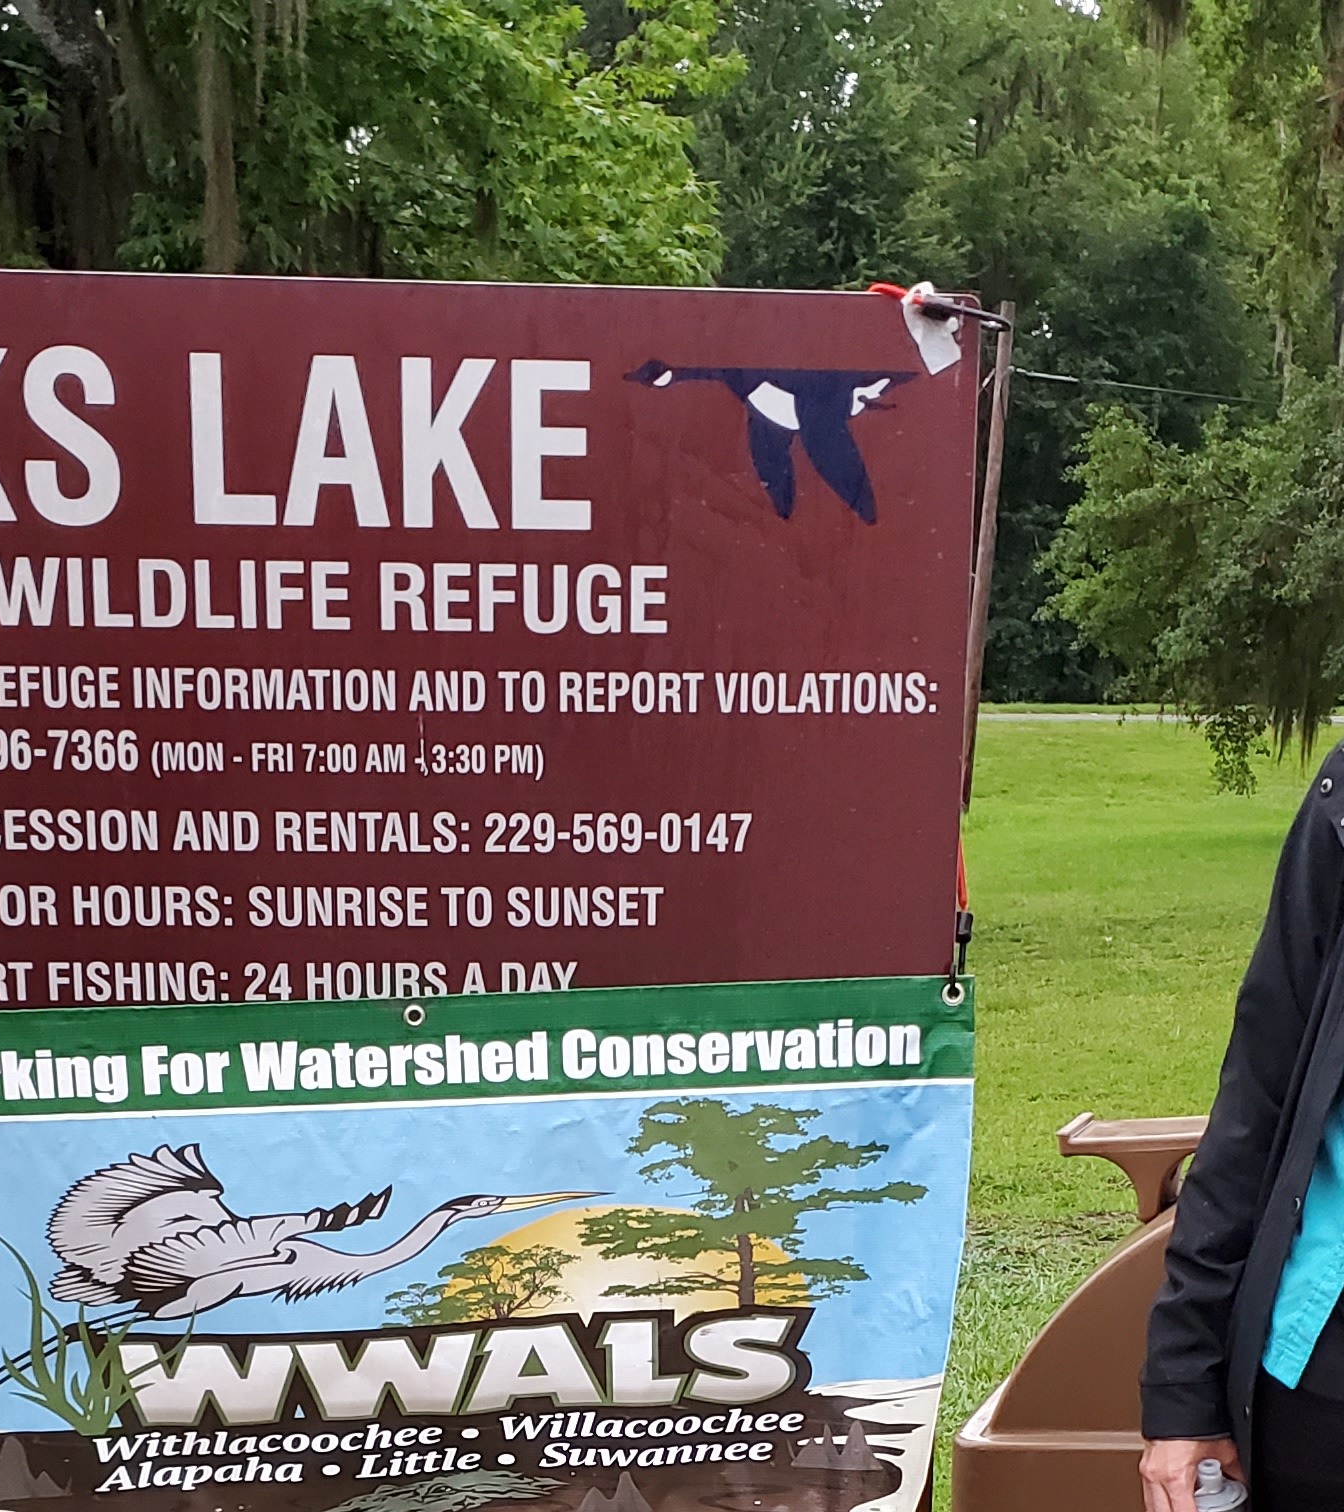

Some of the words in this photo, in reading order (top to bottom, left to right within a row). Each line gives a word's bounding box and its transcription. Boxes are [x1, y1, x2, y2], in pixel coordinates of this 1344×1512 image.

[190, 353, 591, 530] LAKE
[381, 562, 667, 634] REFUGE
[133, 667, 395, 711] INFORMATION
[409, 671, 485, 711] AND
[498, 671, 545, 712] TO
[560, 672, 704, 713] REPORT
[715, 672, 937, 713] VIOLATIONS:
[152, 742, 223, 777] (MON
[252, 743, 293, 771] FRI
[302, 744, 356, 772] 7:00
[365, 744, 405, 772] AM
[432, 745, 485, 773] 3:30
[495, 745, 543, 780] PM)
[173, 811, 259, 851] AND
[276, 812, 469, 853] RENTALS:
[485, 813, 752, 853] 229-569-0147
[73, 885, 232, 926] HOURS:
[249, 886, 427, 927] SUNRISE
[441, 887, 492, 927] TO
[508, 886, 664, 927] SUNSET
[48, 962, 229, 1001] FISHING:
[243, 963, 292, 1000] 24
[306, 963, 447, 999] HOURS
[462, 962, 486, 995] A
[501, 962, 577, 993] DAY
[142, 1046, 229, 1095] For
[240, 1031, 548, 1091] Watershed
[562, 1019, 920, 1079] Conservation
[120, 1318, 790, 1425] WWALS
[93, 1424, 442, 1462] Withlacoochee
[500, 1409, 804, 1439] Willacoochee
[95, 1457, 302, 1491] Alapaha
[356, 1448, 481, 1478] Little
[539, 1443, 773, 1467] Suwannee
